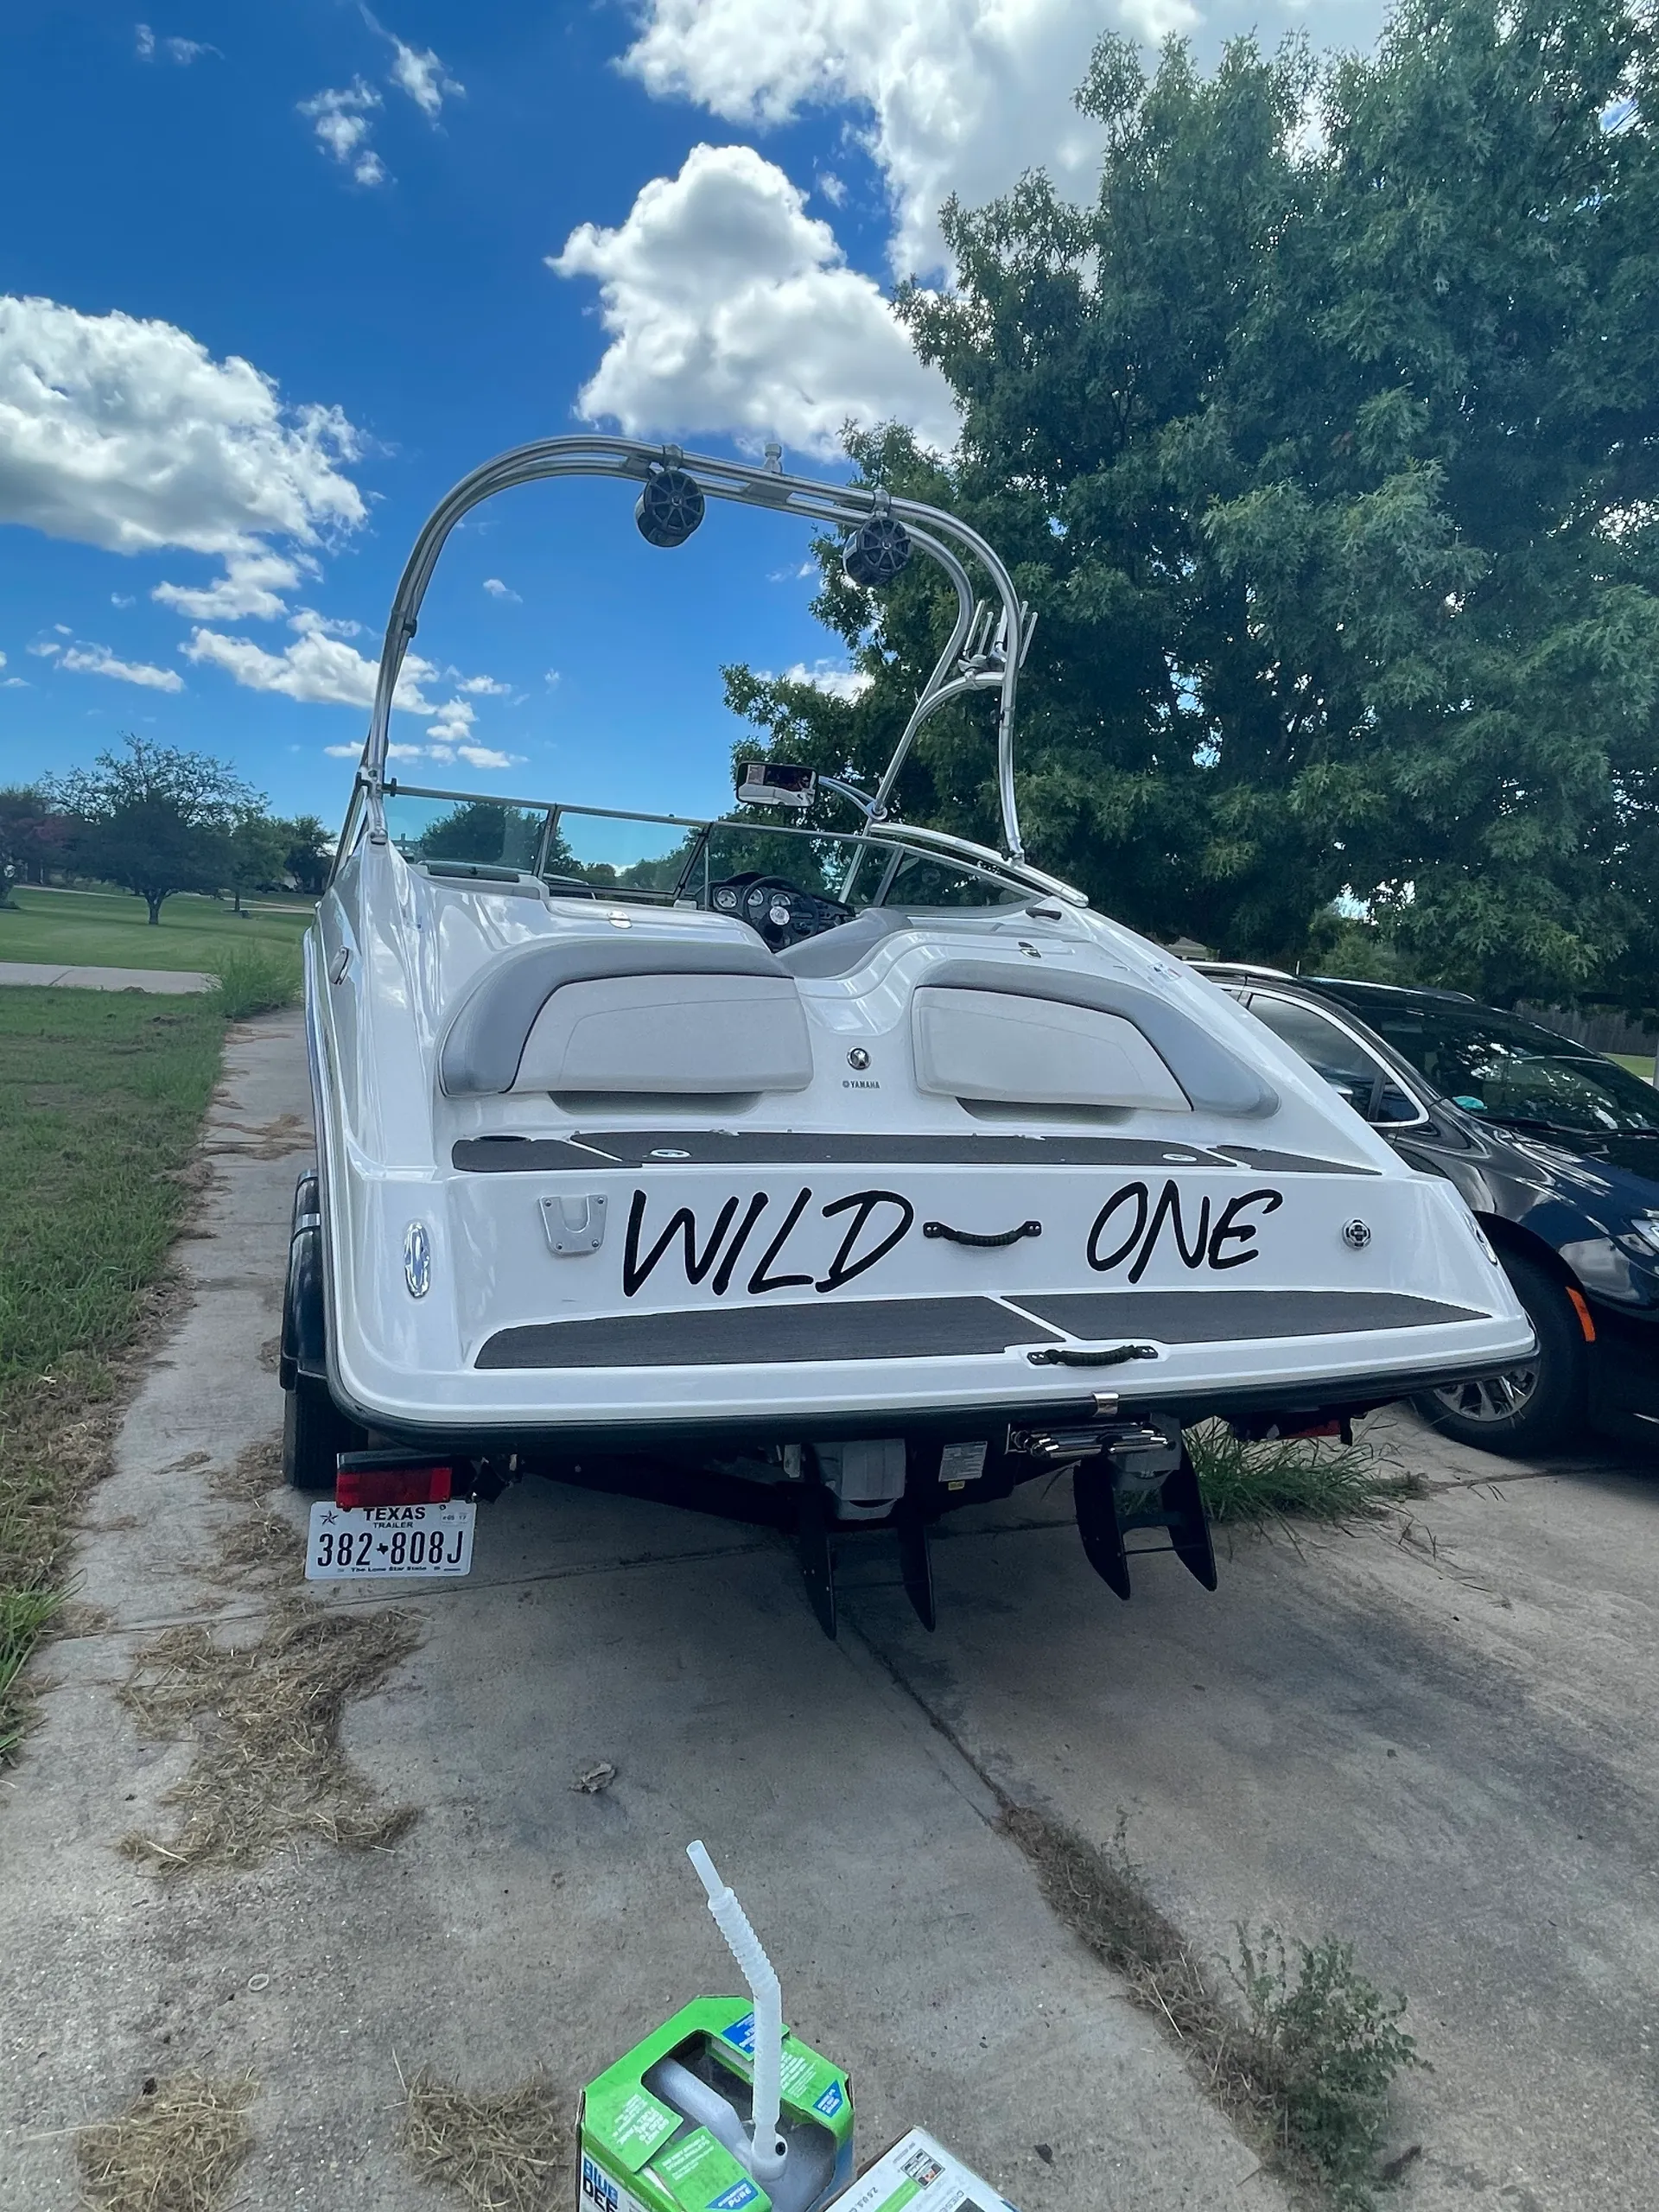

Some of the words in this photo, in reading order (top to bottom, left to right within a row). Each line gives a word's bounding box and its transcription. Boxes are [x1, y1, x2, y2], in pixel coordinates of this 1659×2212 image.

[850, 1080, 880, 1089] YAMAHA
[624, 1187, 914, 1297] WILD
[1087, 1179, 1282, 1284] ONE
[363, 1506, 426, 1521] TEXAS
[583, 2158, 618, 2205] BLUE
